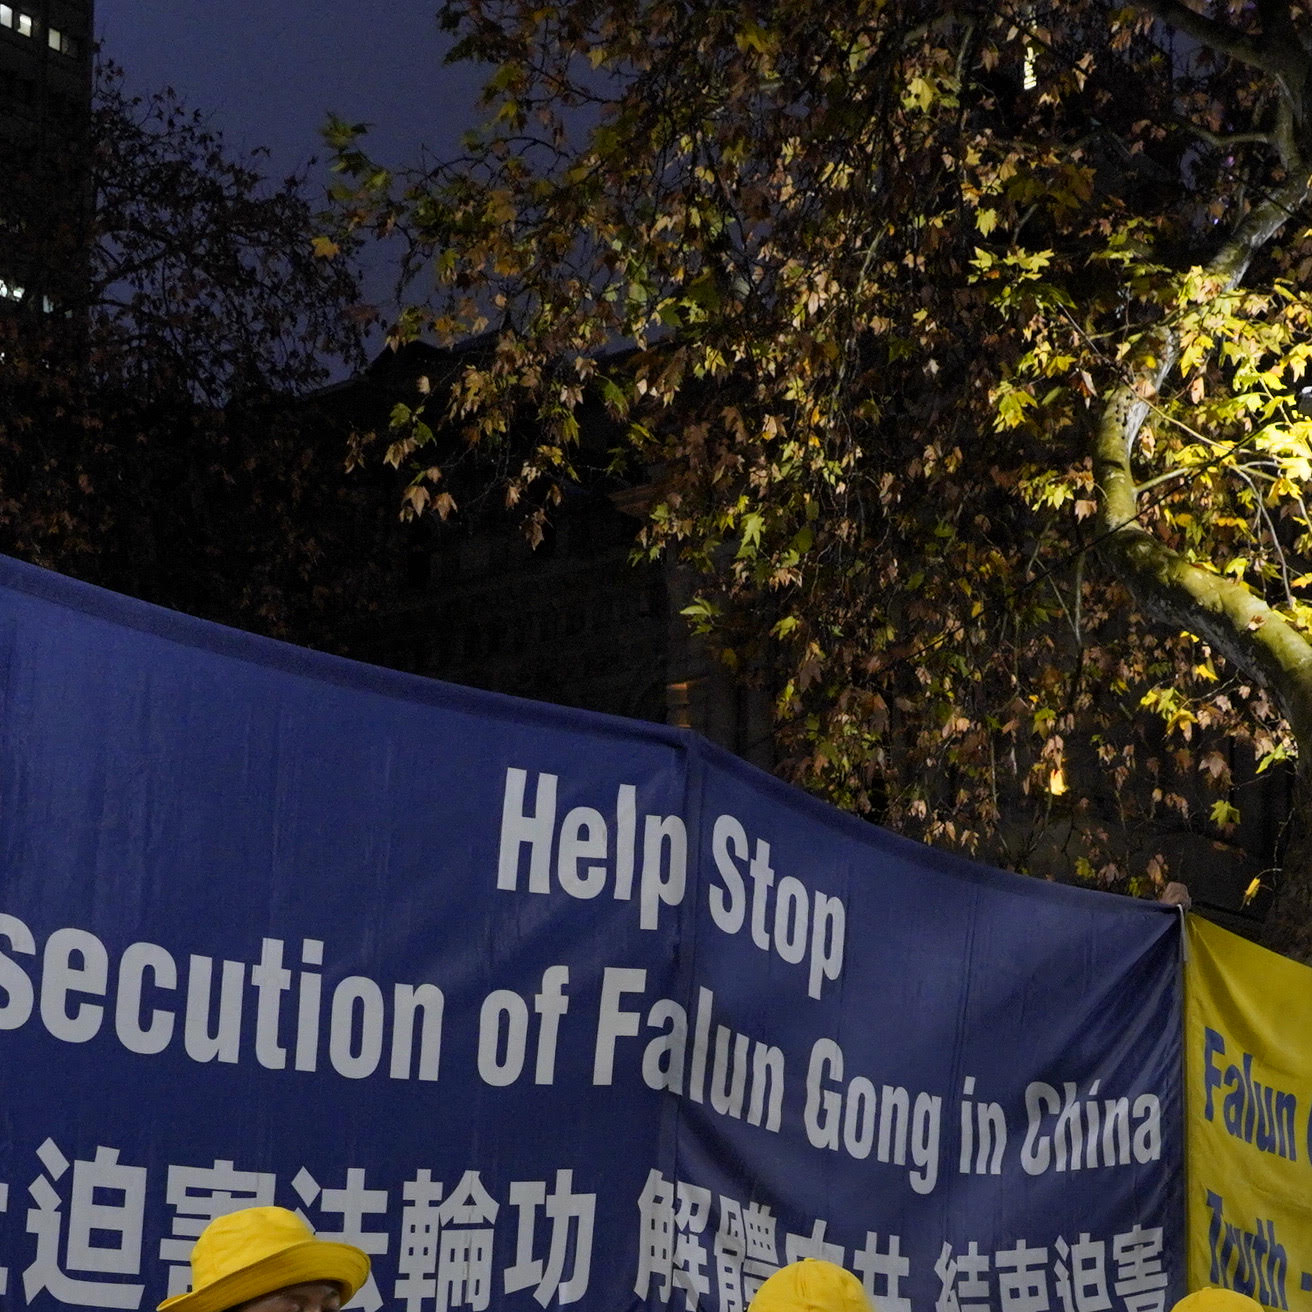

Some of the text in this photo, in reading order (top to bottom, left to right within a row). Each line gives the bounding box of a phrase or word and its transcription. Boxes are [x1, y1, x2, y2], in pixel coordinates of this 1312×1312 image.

[497, 767, 846, 1000] Help Stop
[478, 965, 569, 1087] of
[592, 966, 785, 1133] Falun
[806, 1037, 942, 1195] Gong
[959, 1075, 1007, 1175] in
[1021, 1079, 1161, 1176] China
[1204, 1026, 1297, 1162] Falun
[1206, 1188, 1289, 1311] Truth
